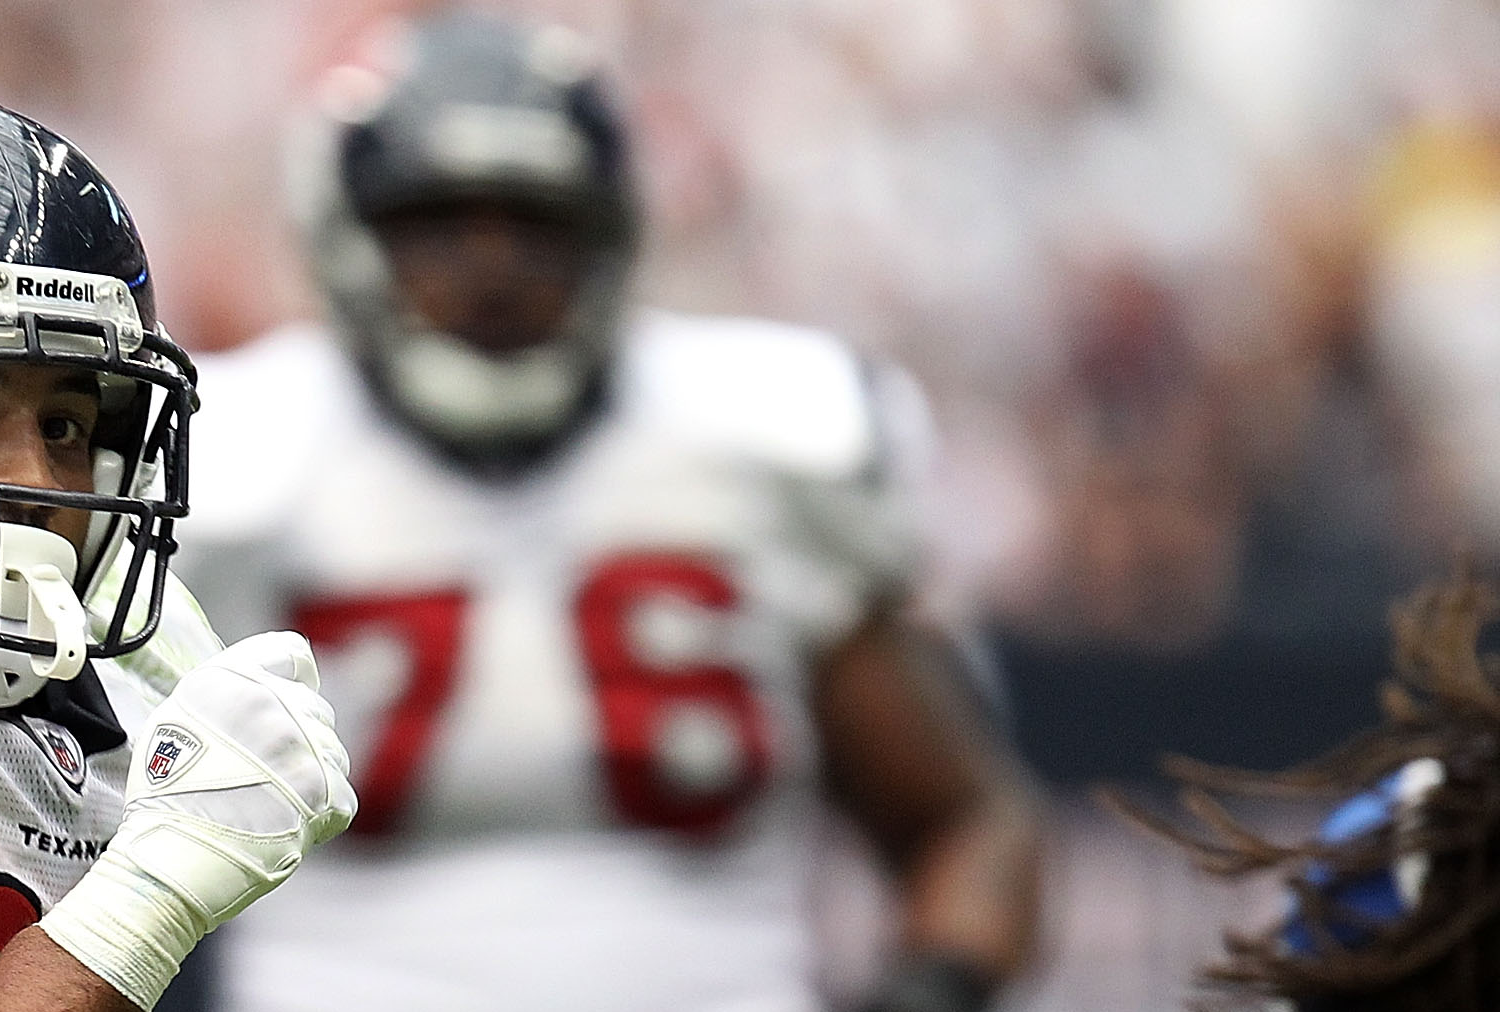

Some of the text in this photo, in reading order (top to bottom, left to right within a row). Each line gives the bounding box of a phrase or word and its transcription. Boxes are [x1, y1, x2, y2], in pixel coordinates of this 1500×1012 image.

[16, 276, 96, 303] Riddell
[286, 553, 772, 838] 76
[150, 754, 171, 776] NFL
[18, 823, 108, 861] TEXAN
